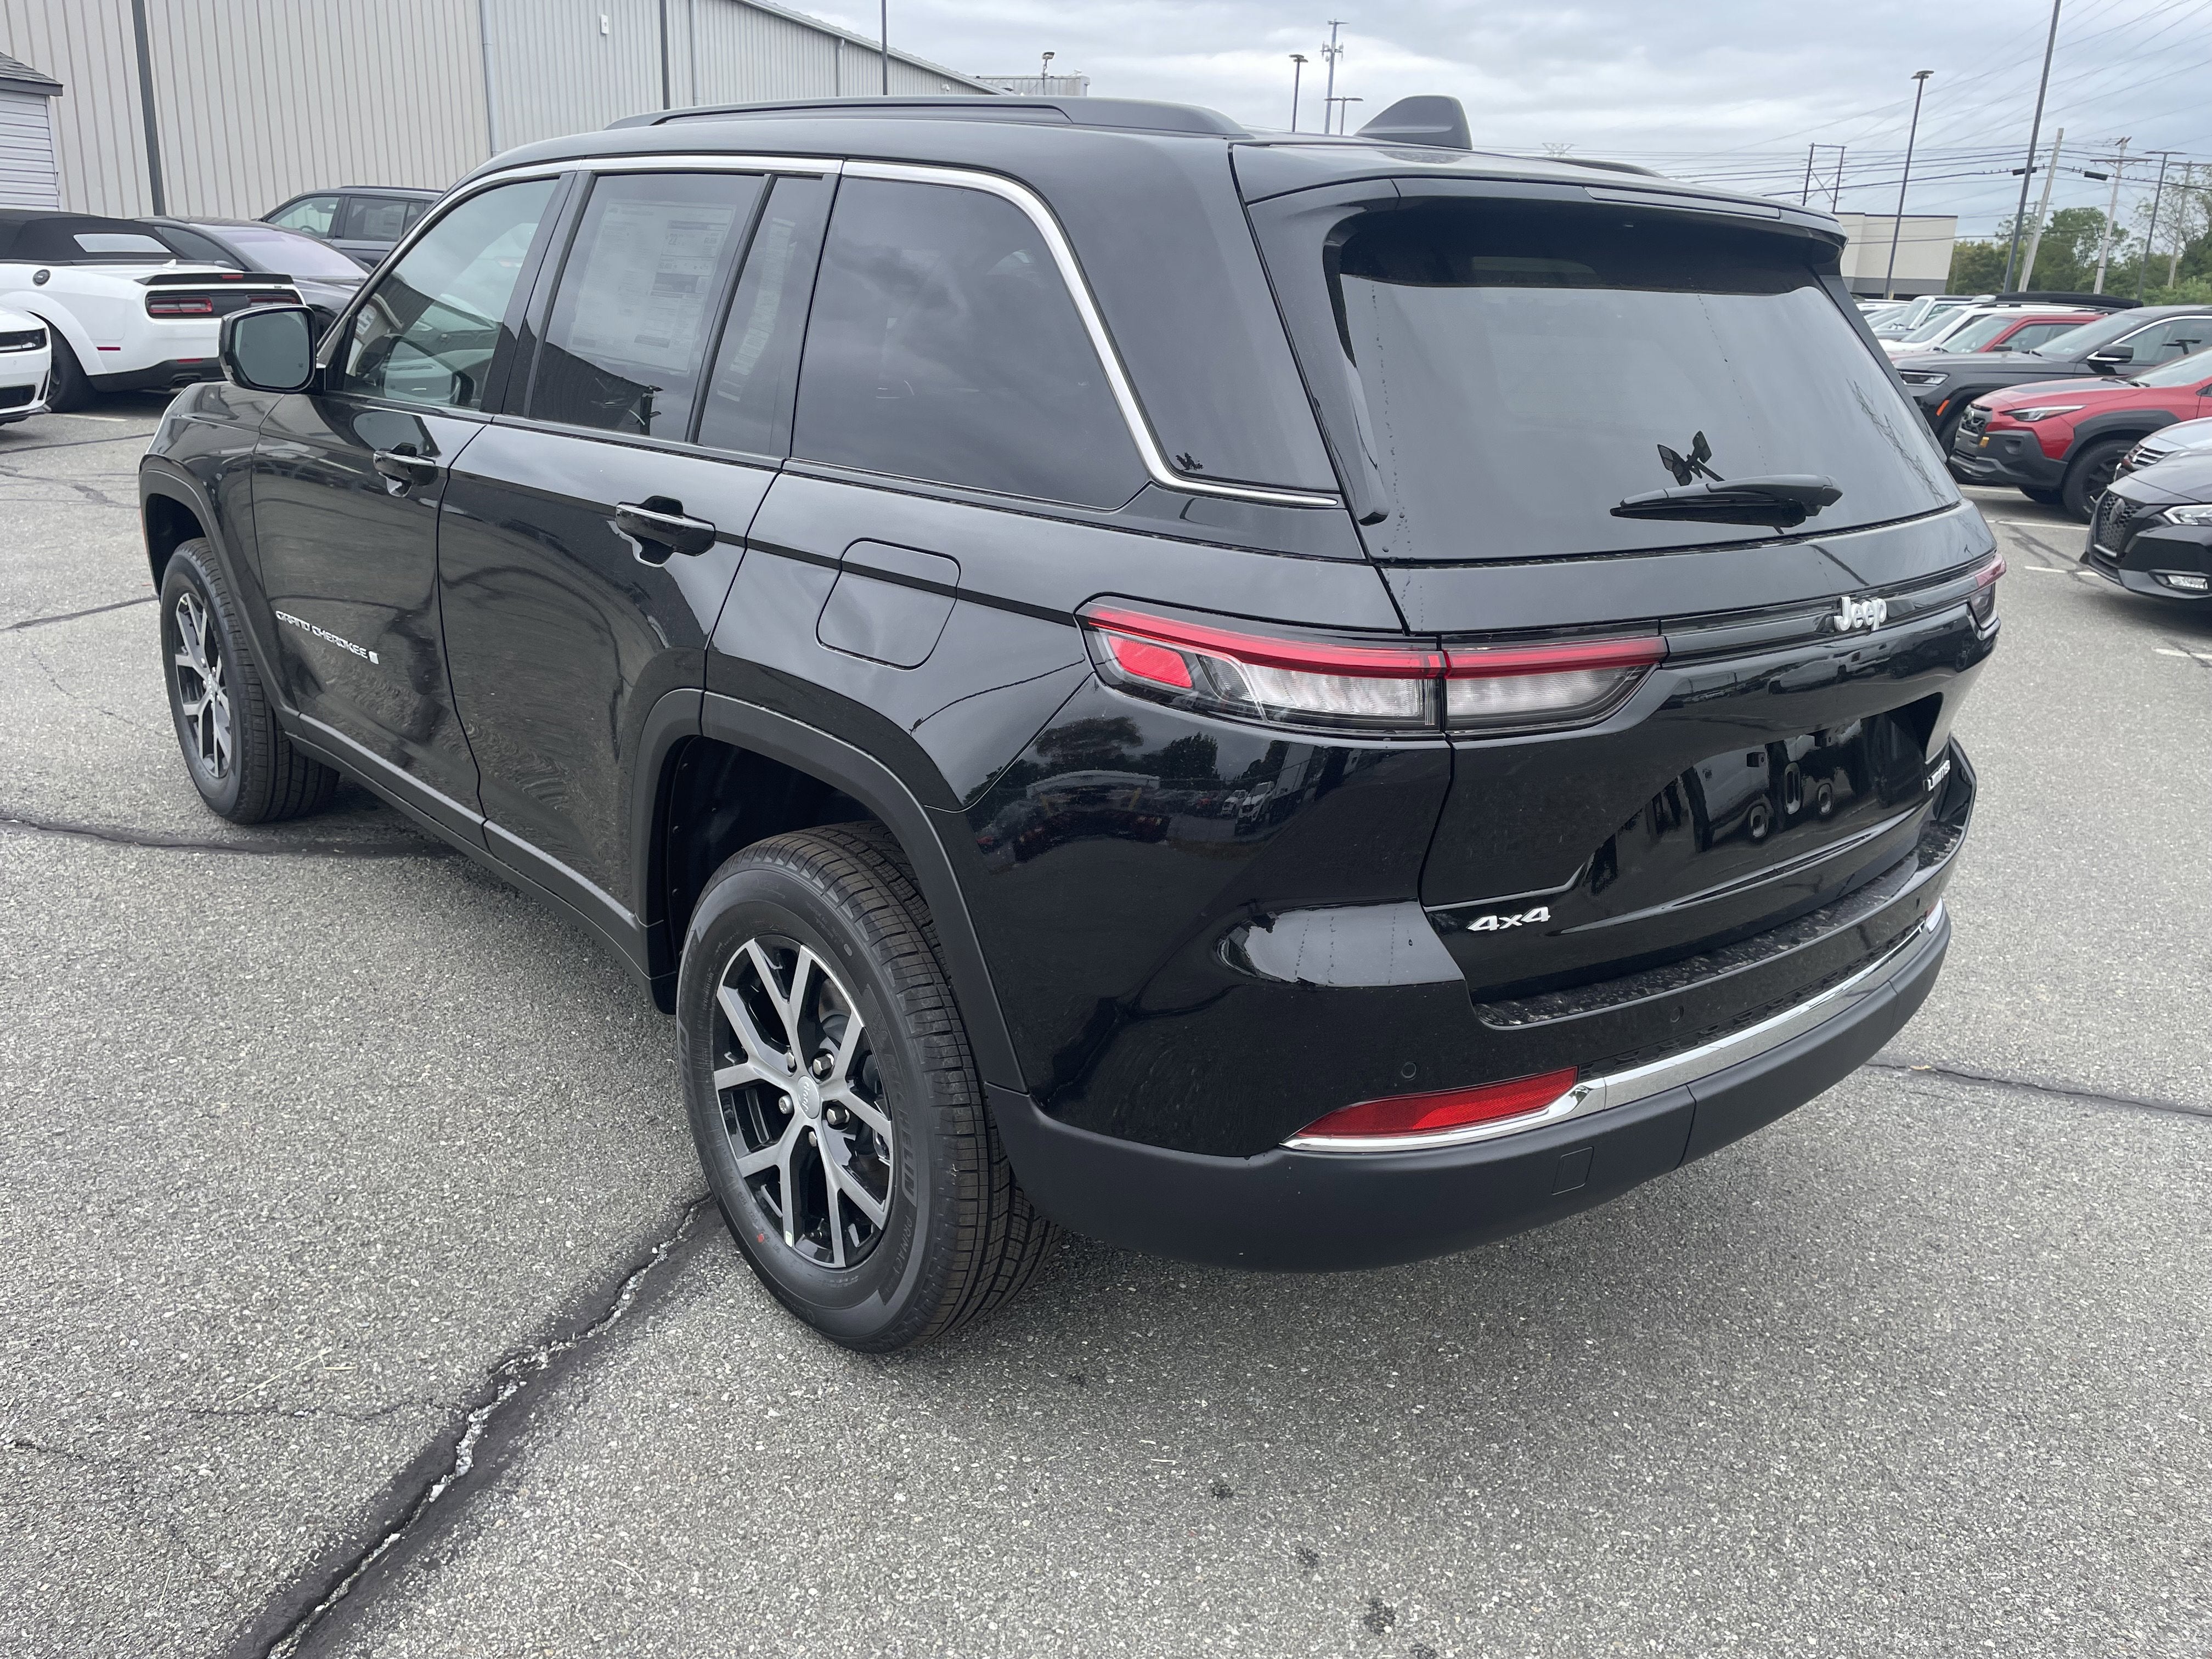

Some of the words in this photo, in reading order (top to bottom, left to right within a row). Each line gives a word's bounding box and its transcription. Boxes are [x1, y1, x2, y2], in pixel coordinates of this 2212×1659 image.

[1834, 596, 1887, 631] Jeep
[275, 610, 311, 631] GRAND
[312, 625, 368, 659] CHEROKEE
[1467, 906, 1551, 931] 4x4
[799, 1081, 810, 1112] Jeep
